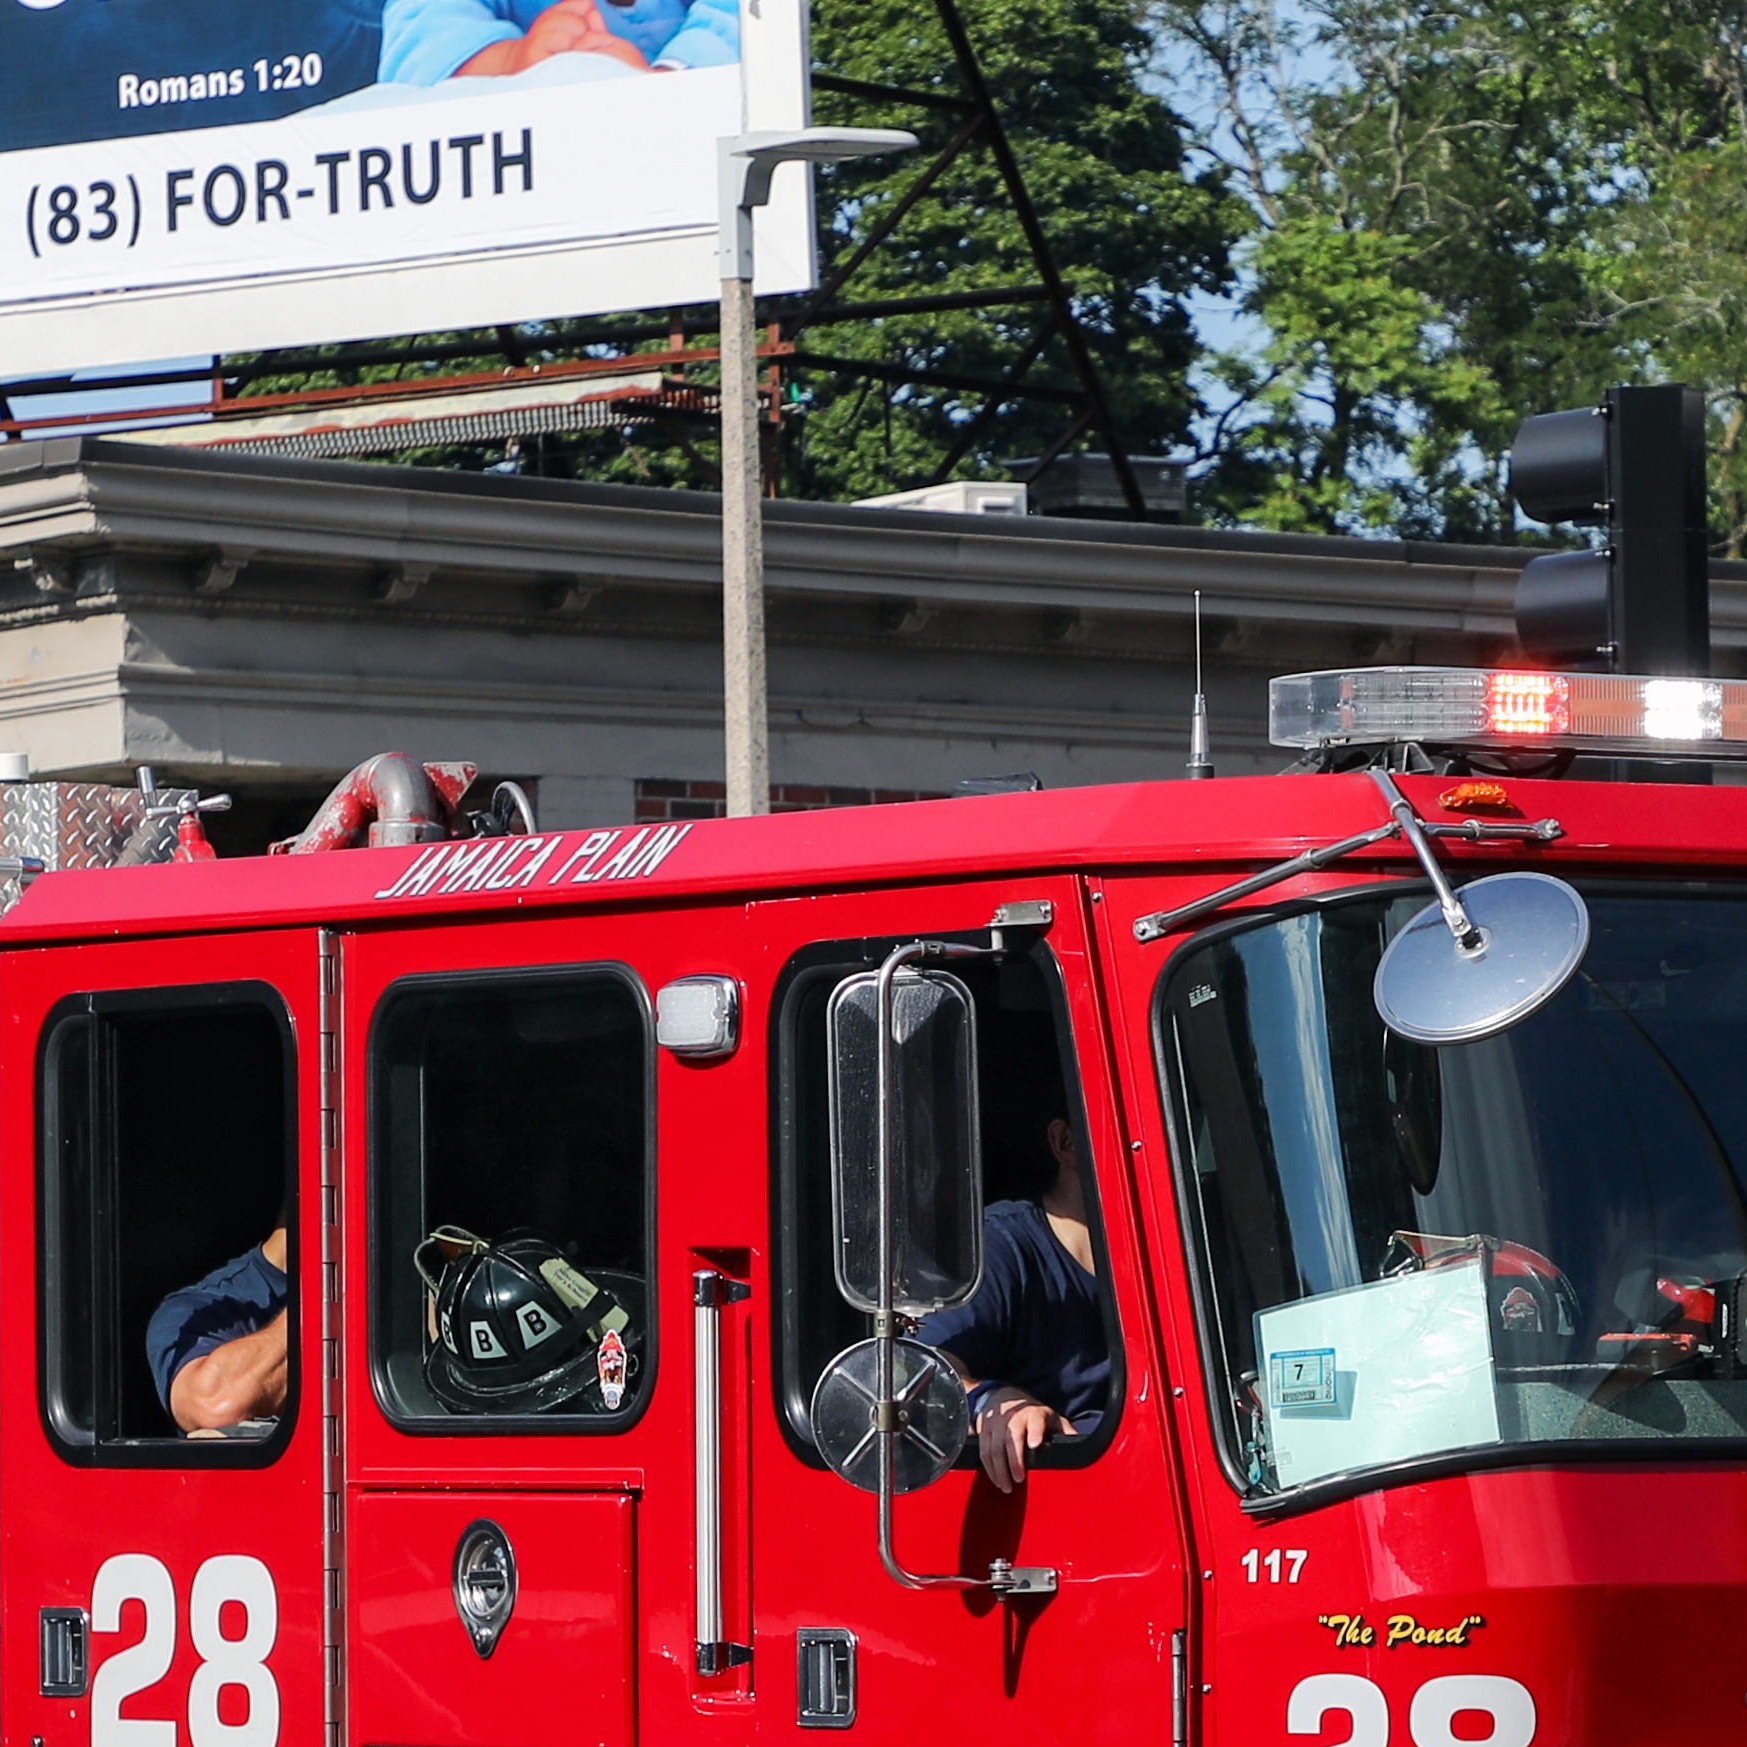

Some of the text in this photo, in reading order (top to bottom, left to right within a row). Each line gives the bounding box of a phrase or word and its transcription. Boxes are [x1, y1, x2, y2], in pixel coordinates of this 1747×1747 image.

[118, 53, 323, 108] Romans 1:20
[26, 173, 141, 257] (83)
[166, 127, 533, 233] FOR-TRUTH
[374, 823, 694, 899] JAMAICA PLAIN
[1294, 1363, 1304, 1381] 7
[1241, 1549, 1309, 1584] 117
[1318, 1614, 1484, 1648] "The Pond"
